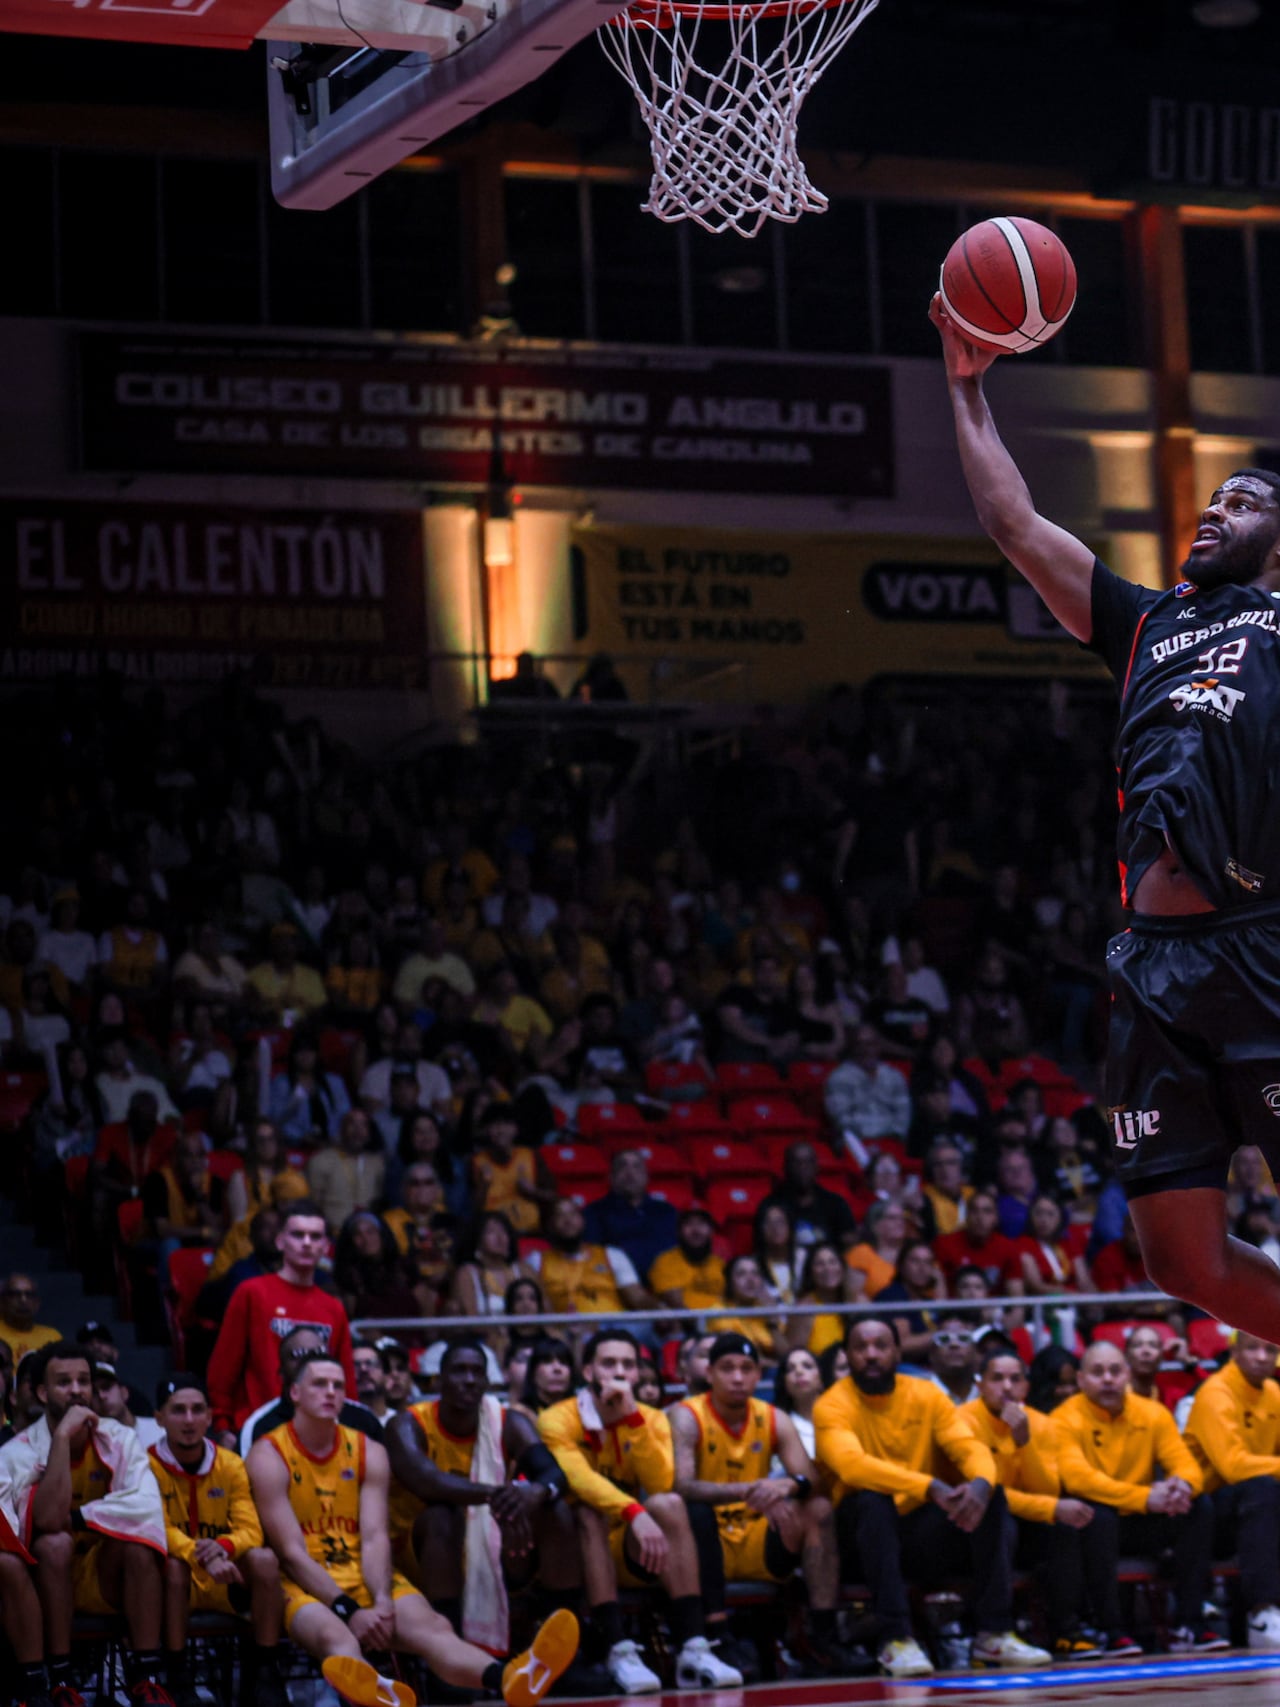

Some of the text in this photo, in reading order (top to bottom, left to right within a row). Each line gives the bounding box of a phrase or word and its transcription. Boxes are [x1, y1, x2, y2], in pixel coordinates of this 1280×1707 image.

[114, 370, 868, 436] COLISEO GUILLERMO ANGULO
[174, 417, 270, 444] CASA
[281, 420, 333, 447] DE
[340, 422, 407, 448] LOS
[593, 432, 640, 457] DE
[650, 436, 813, 464] CAROLINA
[15, 514, 386, 598] EL CALENTÓN
[617, 549, 790, 579] EL FUTURO
[619, 579, 751, 610] ESTÁ EN
[878, 574, 998, 613] VOTA
[623, 618, 803, 644] TUS MANOS
[1190, 636, 1248, 675] 32
[1113, 1108, 1162, 1150] Lite
